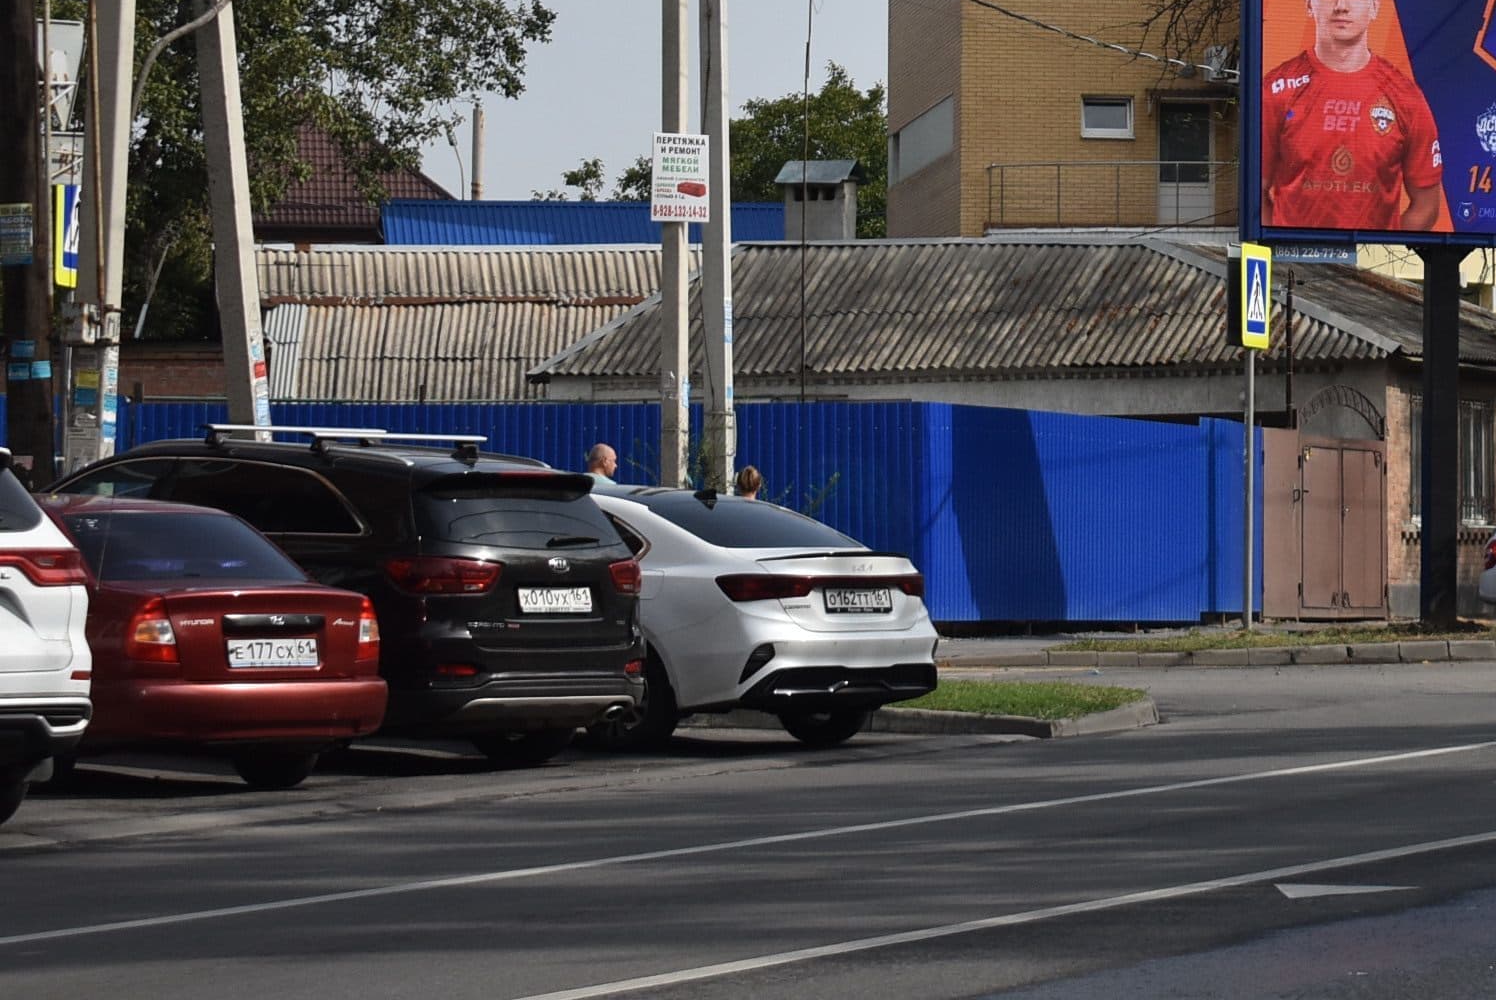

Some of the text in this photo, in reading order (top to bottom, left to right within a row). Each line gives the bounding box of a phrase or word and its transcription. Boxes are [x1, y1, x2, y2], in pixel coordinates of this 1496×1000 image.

[1323, 99, 1361, 114] FON
[1323, 116, 1360, 131] BET
[656, 136, 706, 146] ПЕРЕТЯЖКА
[668, 147, 701, 155] РЕМОНТ
[662, 157, 699, 165] МЯГКОЙ
[662, 165, 699, 173] МЕБЕЛИ
[1469, 166, 1492, 193] 14
[1275, 247, 1299, 257] (863)
